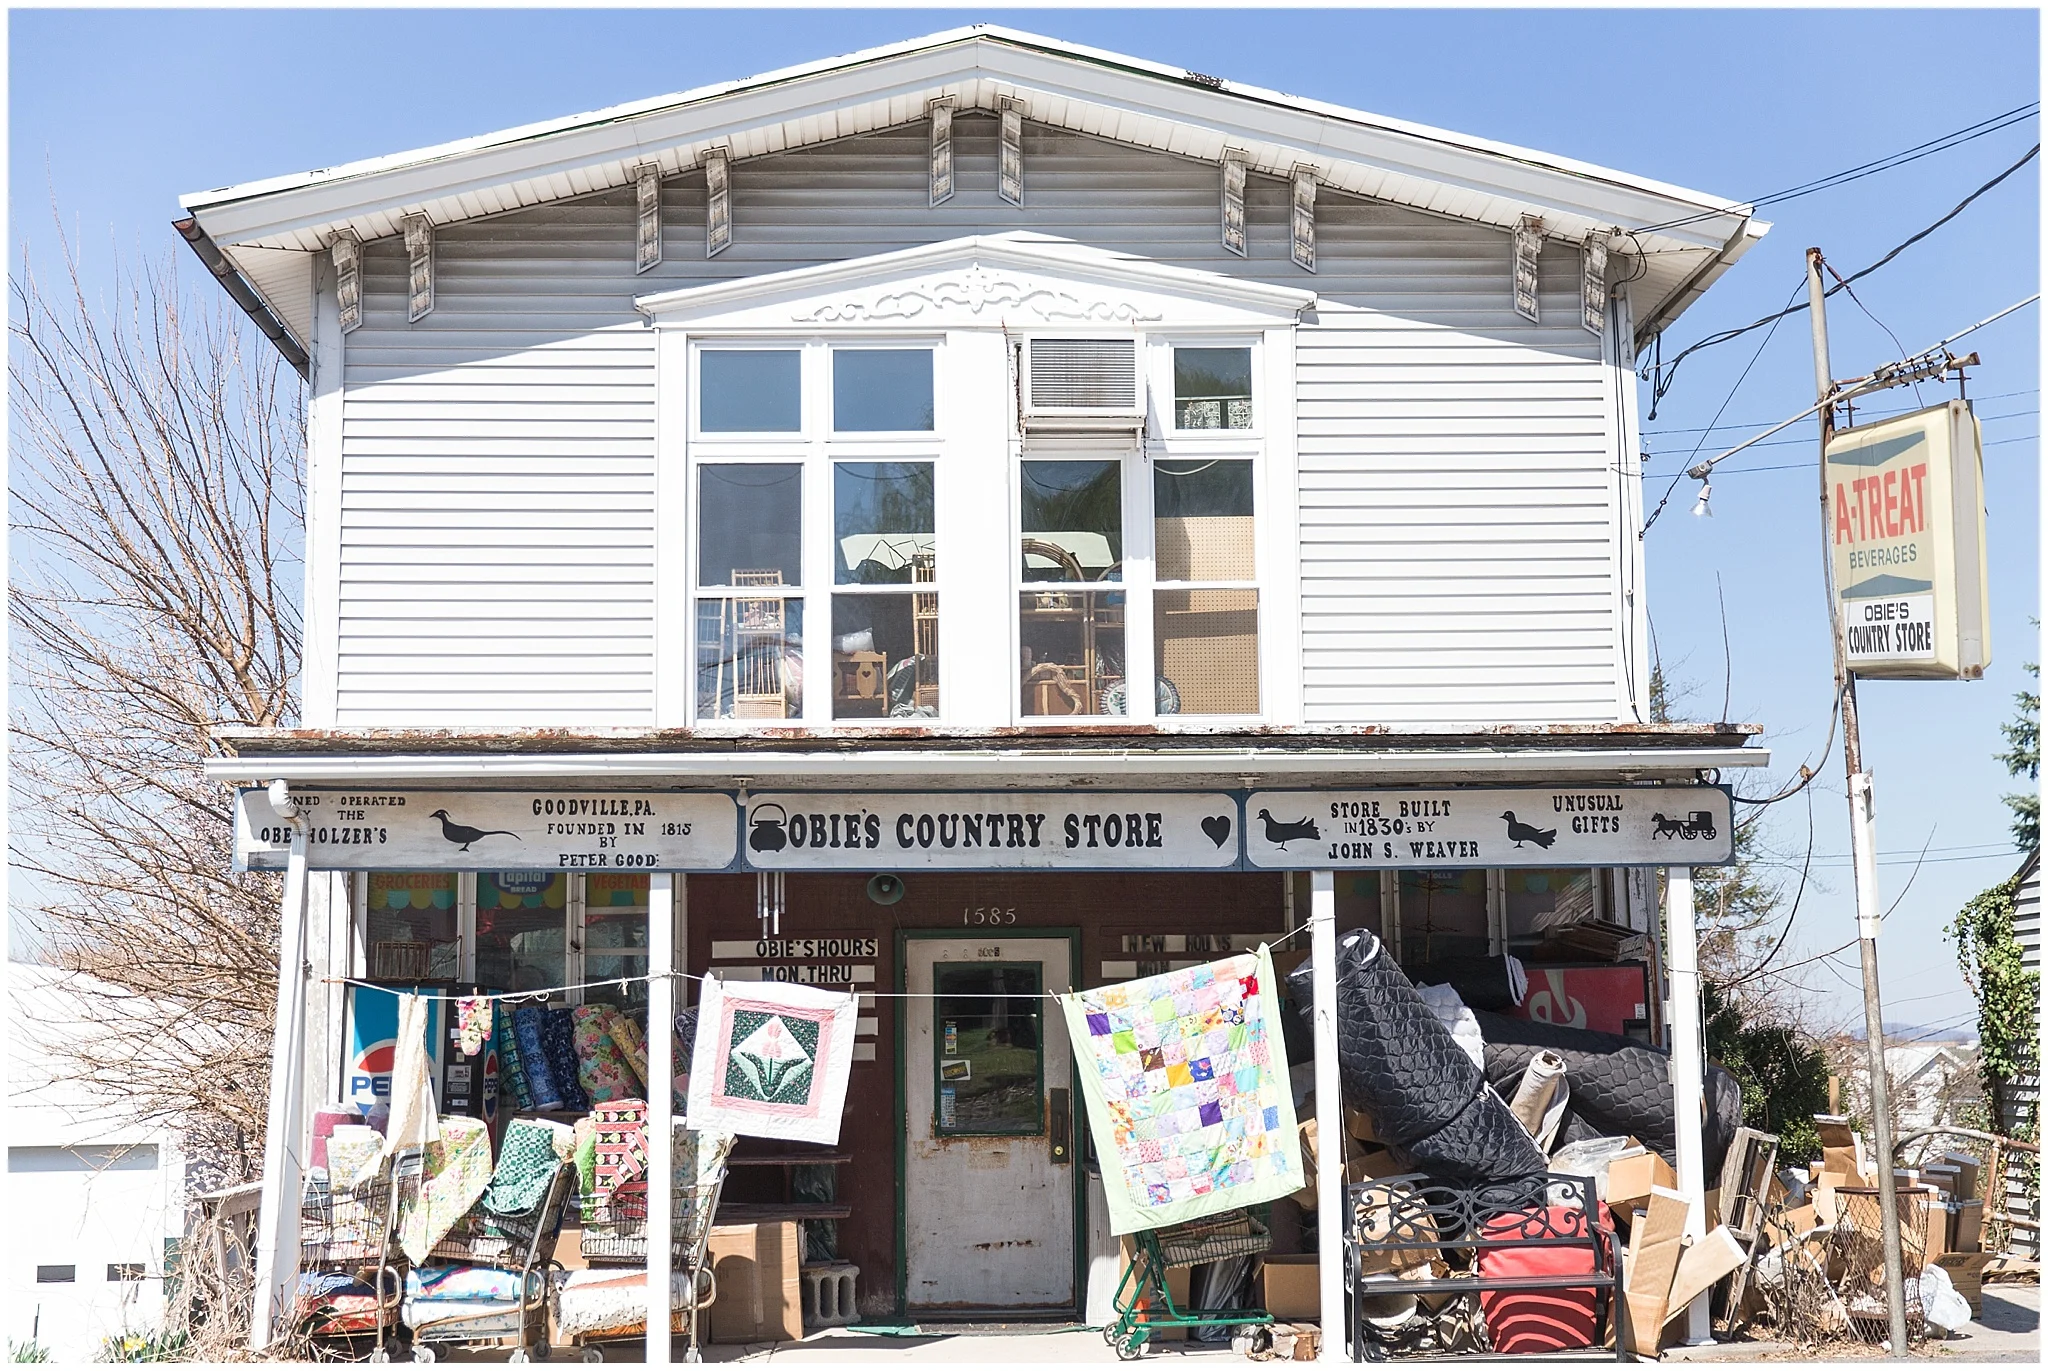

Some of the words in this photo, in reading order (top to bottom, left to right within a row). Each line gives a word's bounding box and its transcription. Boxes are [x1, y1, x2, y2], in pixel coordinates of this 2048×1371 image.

[1836, 463, 1926, 545] A-TREAT
[1849, 543, 1918, 570] BEVERAGES
[1864, 602, 1910, 622] OBIE'S
[1848, 623, 1891, 655] COUNTRY
[1895, 621, 1932, 653] STORE
[340, 796, 407, 806] OPERATED
[1330, 801, 1380, 818] STORE
[1399, 800, 1451, 817] BUILT
[1552, 795, 1623, 812] UNUSUAL
[337, 810, 365, 820] THE
[547, 823, 616, 835] FOUNDED
[624, 823, 645, 835] IN
[661, 823, 692, 836] 1815
[788, 809, 881, 848] OBIE'S
[896, 813, 1046, 849] COUNTRY
[1065, 812, 1164, 849] STORE
[1417, 821, 1435, 832] BY
[1572, 816, 1620, 833] GIFTS
[599, 836, 618, 848] BY
[1328, 842, 1373, 859] JOHN
[1384, 842, 1398, 858] S.
[1409, 841, 1479, 858] WEAVER
[558, 853, 608, 867] PETER
[374, 874, 450, 889] GROCERIES
[963, 907, 1017, 925] 1585
[756, 940, 814, 957] OBIE'S
[817, 939, 876, 957] HOURS
[1128, 935, 1165, 952] NEW
